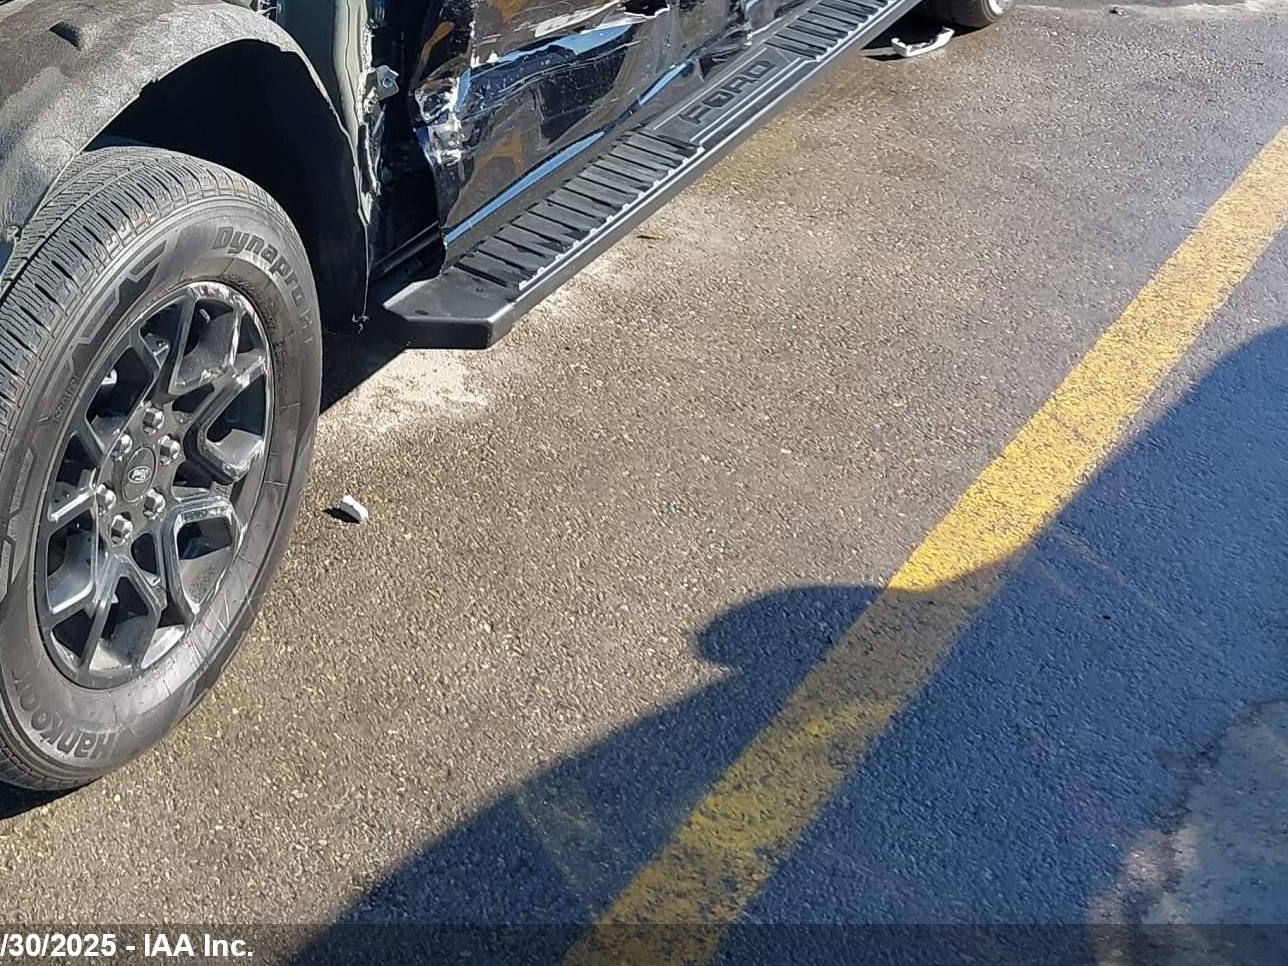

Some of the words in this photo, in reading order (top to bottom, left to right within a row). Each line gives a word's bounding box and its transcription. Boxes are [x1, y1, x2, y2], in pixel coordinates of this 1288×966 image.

[678, 60, 777, 125] FORD
[212, 225, 306, 308] Dynapro
[11, 669, 120, 759] Hankook
